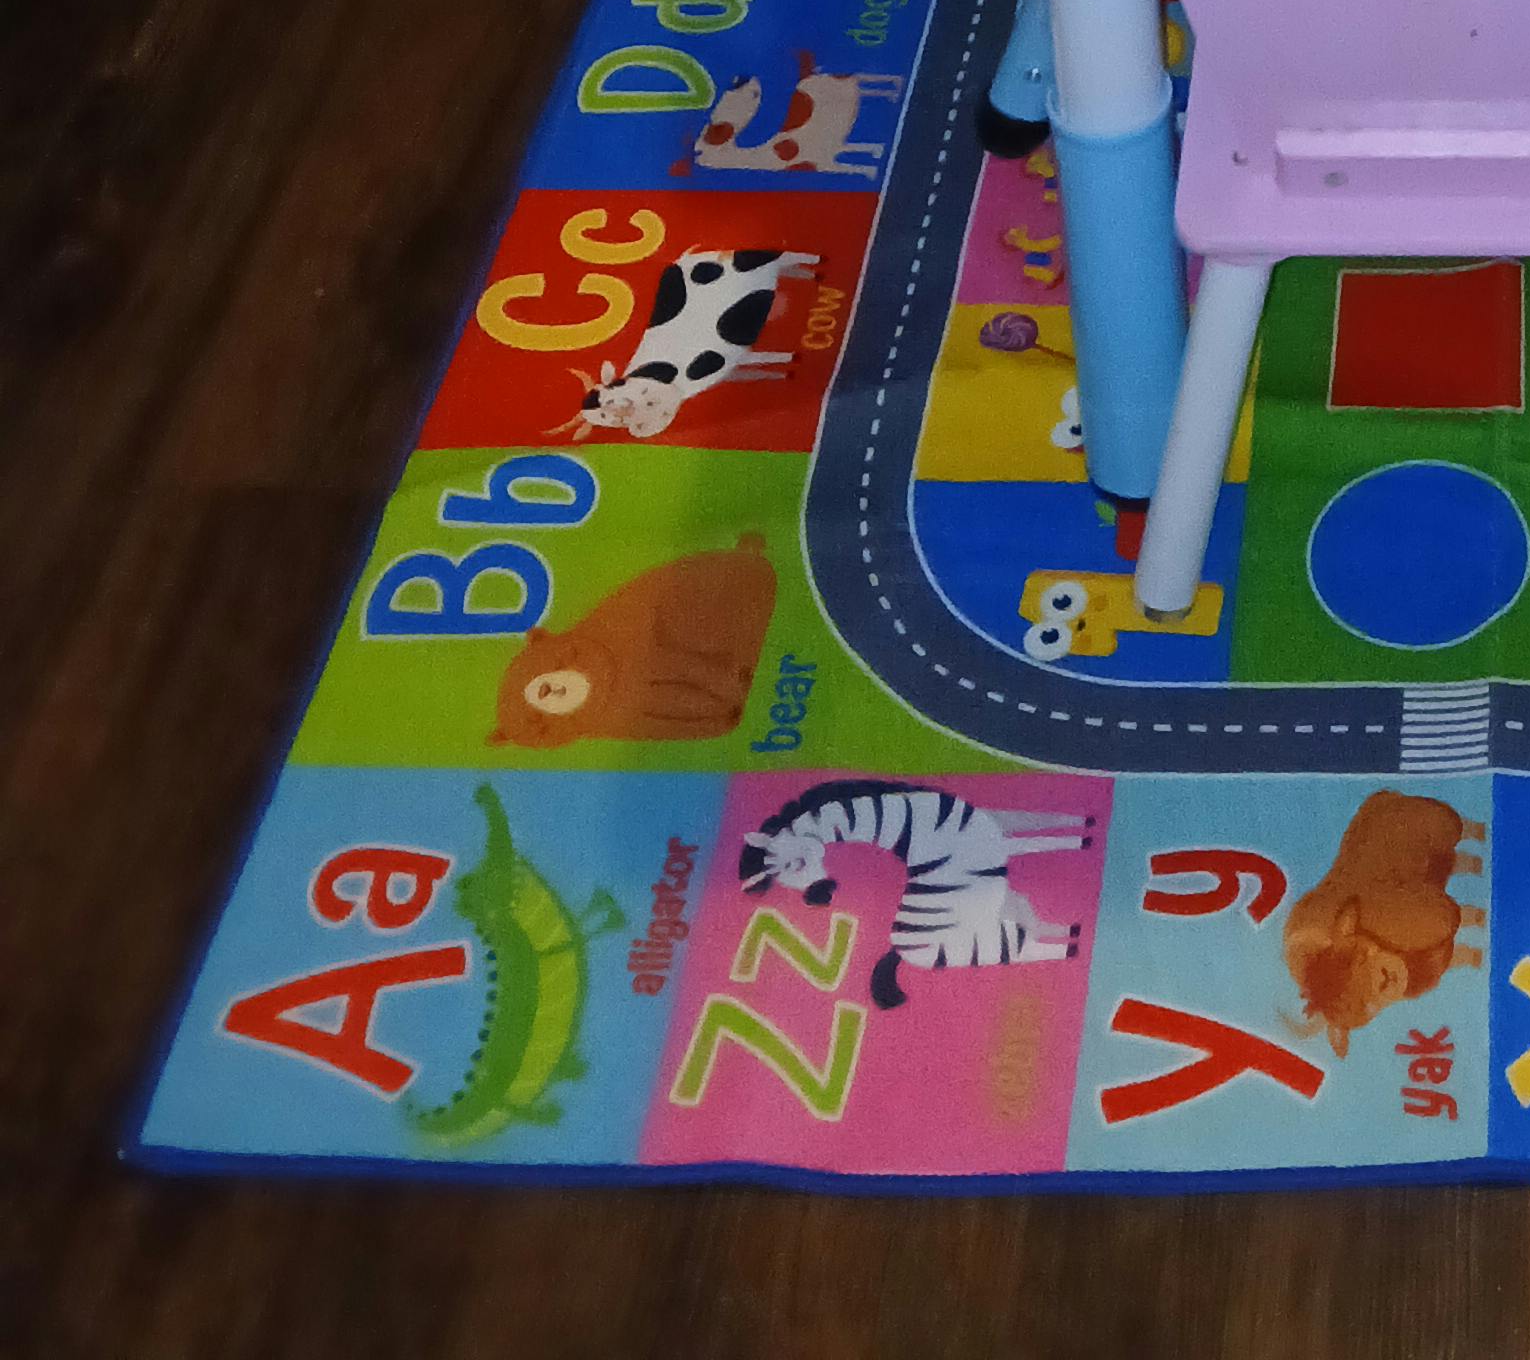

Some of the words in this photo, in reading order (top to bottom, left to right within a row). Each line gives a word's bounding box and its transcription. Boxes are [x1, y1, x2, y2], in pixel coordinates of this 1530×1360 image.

[476, 208, 666, 352] Cc
[802, 284, 846, 352] cow
[360, 451, 600, 641] Bb
[750, 653, 819, 754] bear
[214, 841, 473, 1103] Aa
[627, 835, 699, 997] alligator
[1098, 845, 1326, 1125] Yy
[668, 905, 869, 1122] Zz
[1395, 1025, 1459, 1121] yak
